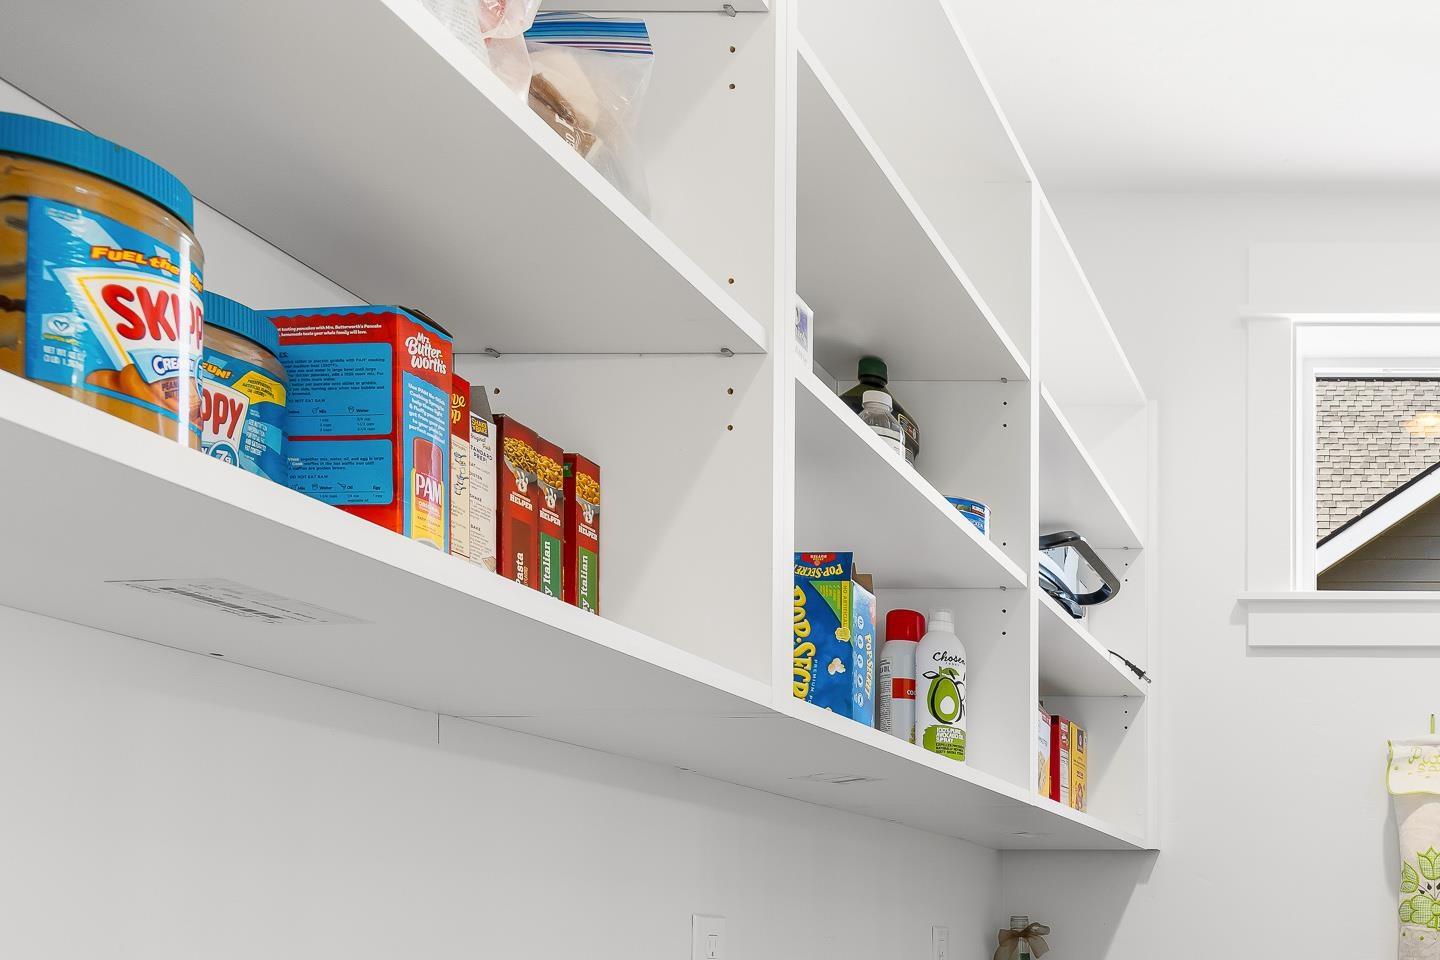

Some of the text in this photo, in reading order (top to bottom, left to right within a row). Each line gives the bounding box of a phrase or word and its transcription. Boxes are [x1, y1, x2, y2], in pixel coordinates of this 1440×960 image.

[415, 473, 441, 506] PAM
[509, 493, 533, 511] HELPER
[540, 510, 561, 526] HELPER
[579, 525, 597, 541] HELPER
[543, 541, 551, 584] Italian
